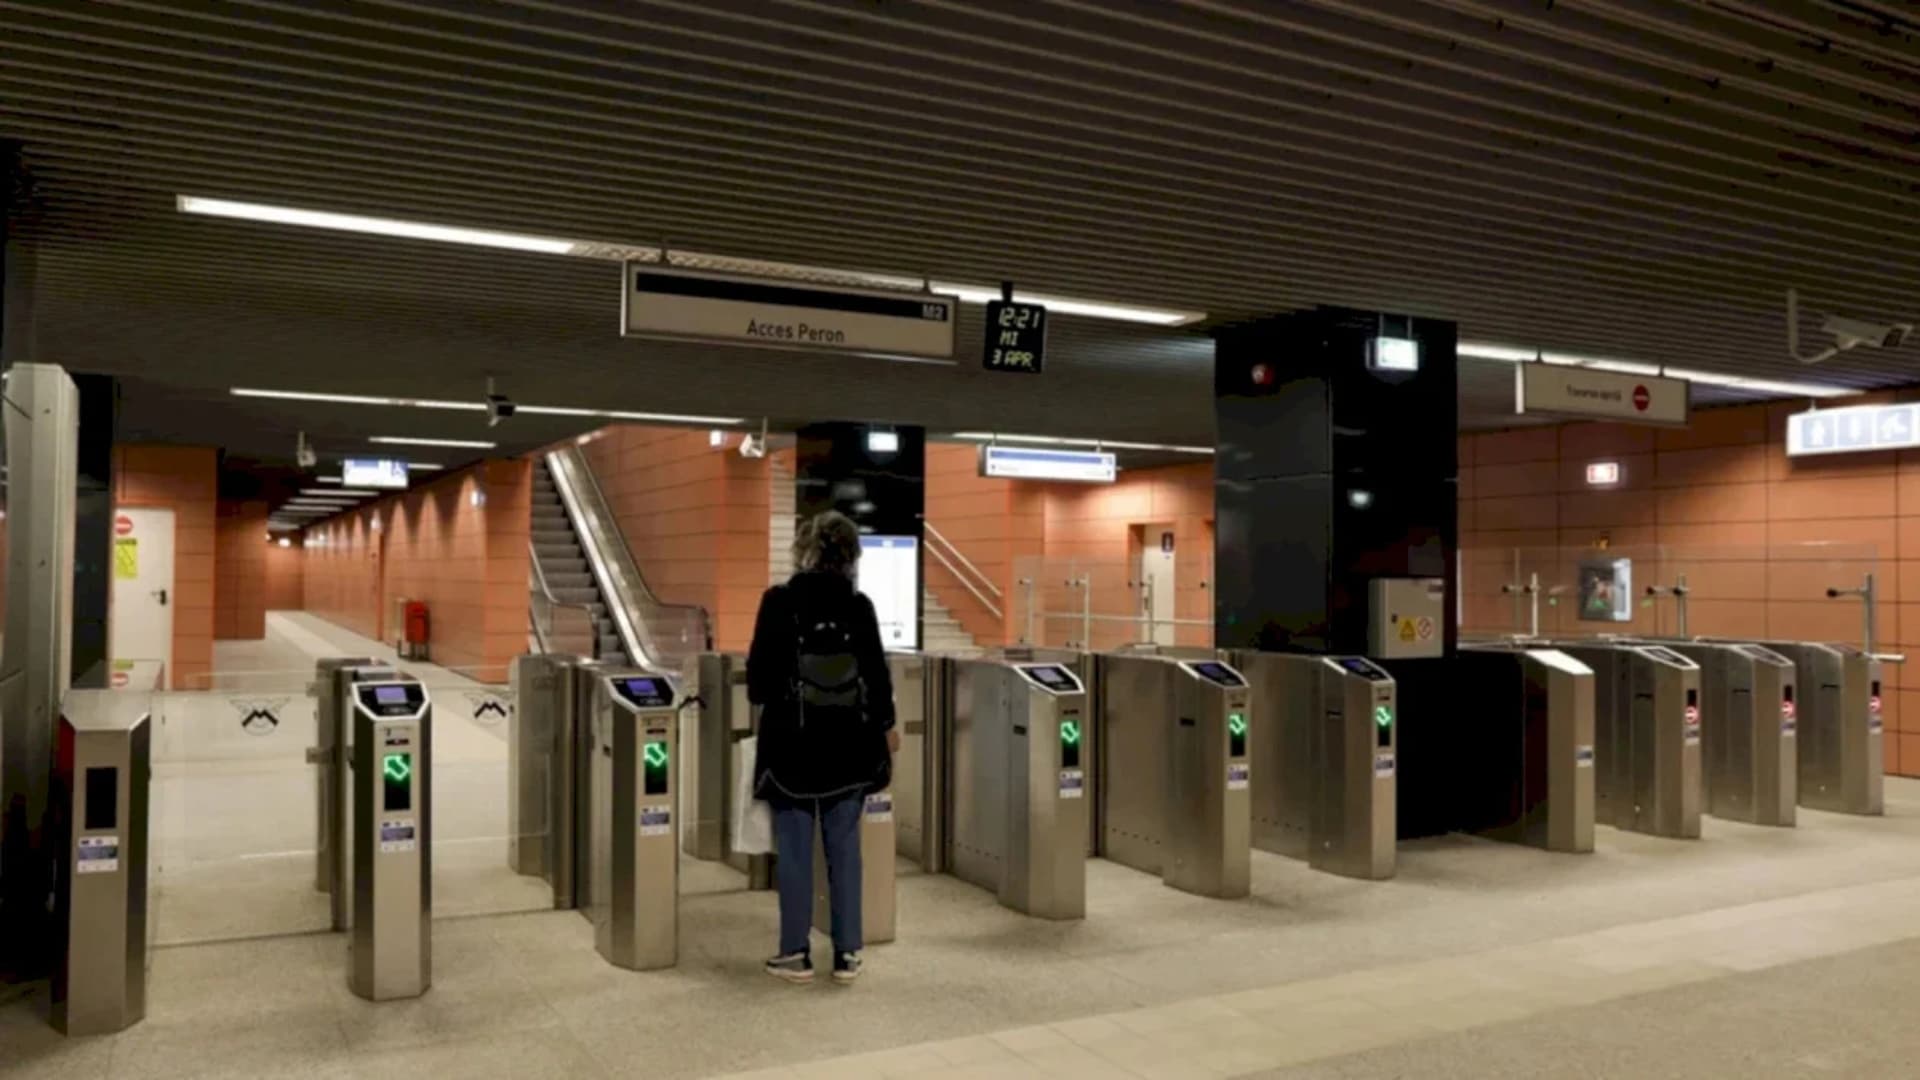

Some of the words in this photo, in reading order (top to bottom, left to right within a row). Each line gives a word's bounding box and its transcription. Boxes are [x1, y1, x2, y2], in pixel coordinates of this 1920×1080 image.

[746, 318, 793, 339] Acces
[798, 322, 844, 343] Peron
[1000, 331, 1018, 346] MI
[992, 349, 1002, 365] 3
[1004, 351, 1034, 367] APR
